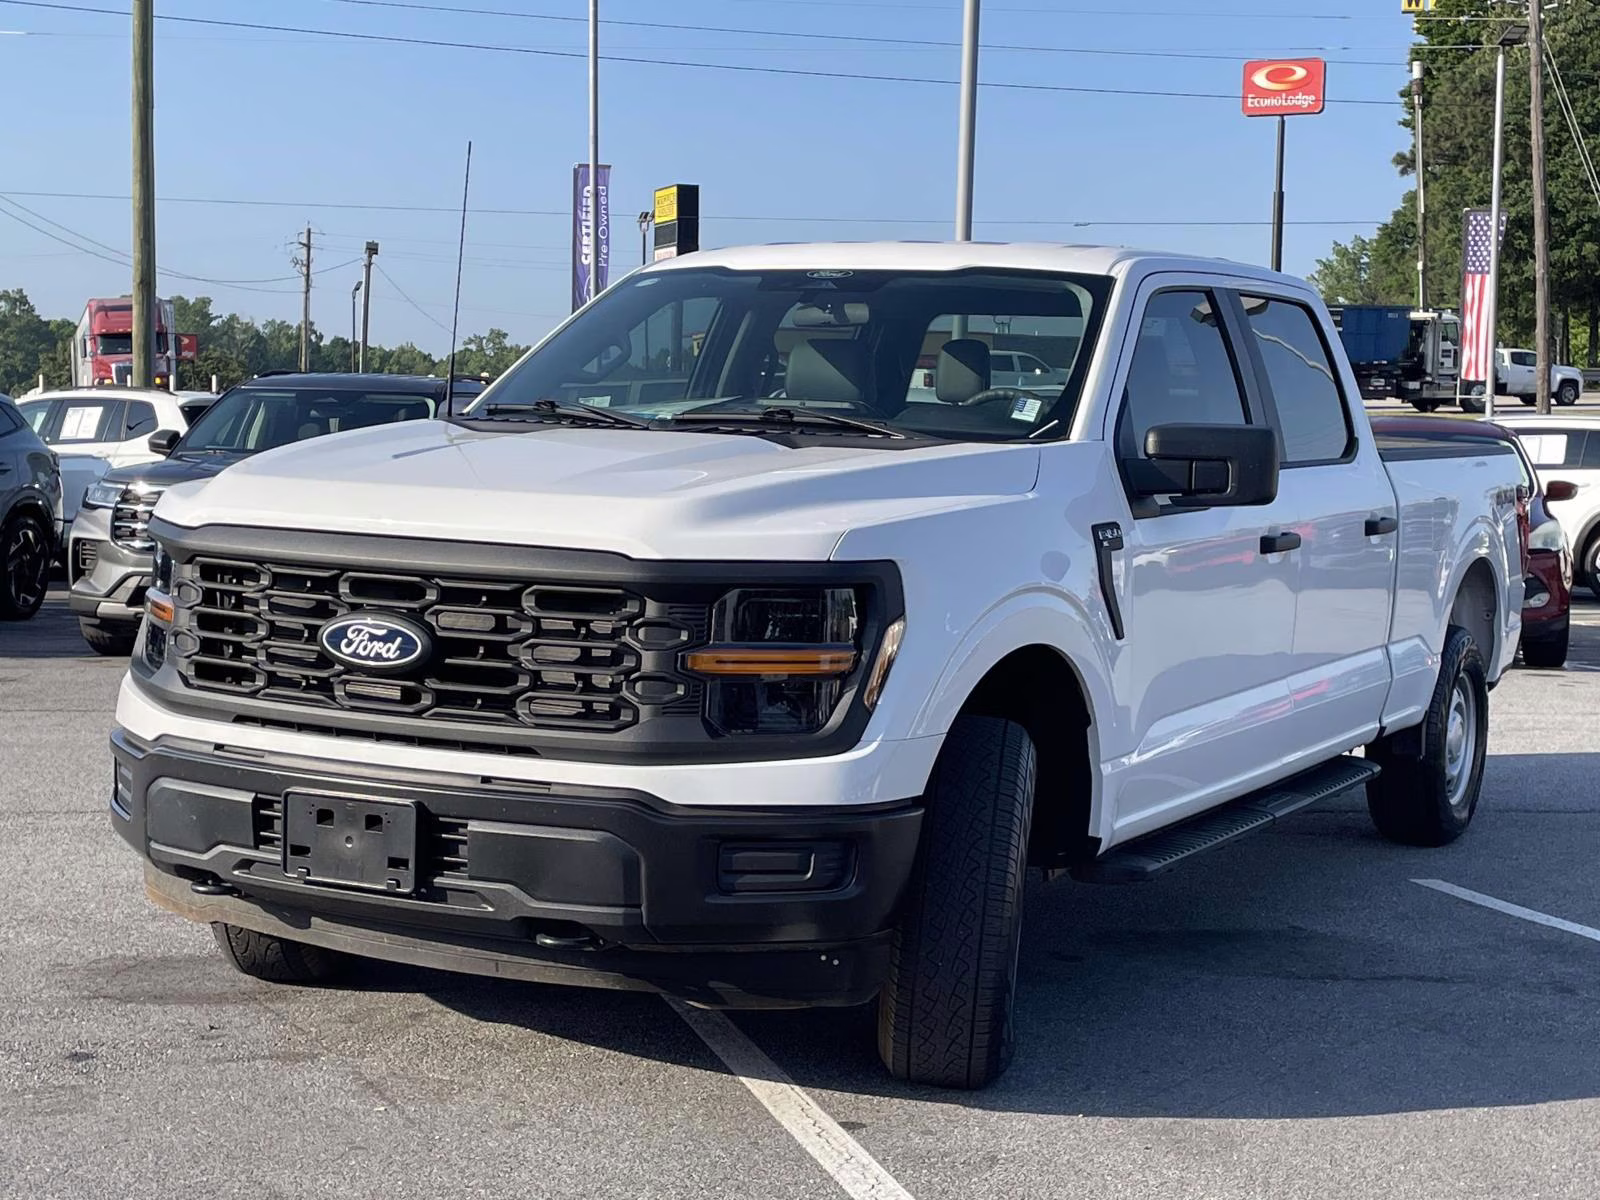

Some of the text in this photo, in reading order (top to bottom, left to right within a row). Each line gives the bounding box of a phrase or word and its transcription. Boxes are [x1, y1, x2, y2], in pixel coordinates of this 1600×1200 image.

[1247, 92, 1316, 108] EconoLodge
[598, 186, 608, 267] Pre-Owned
[340, 624, 402, 659] Ford
